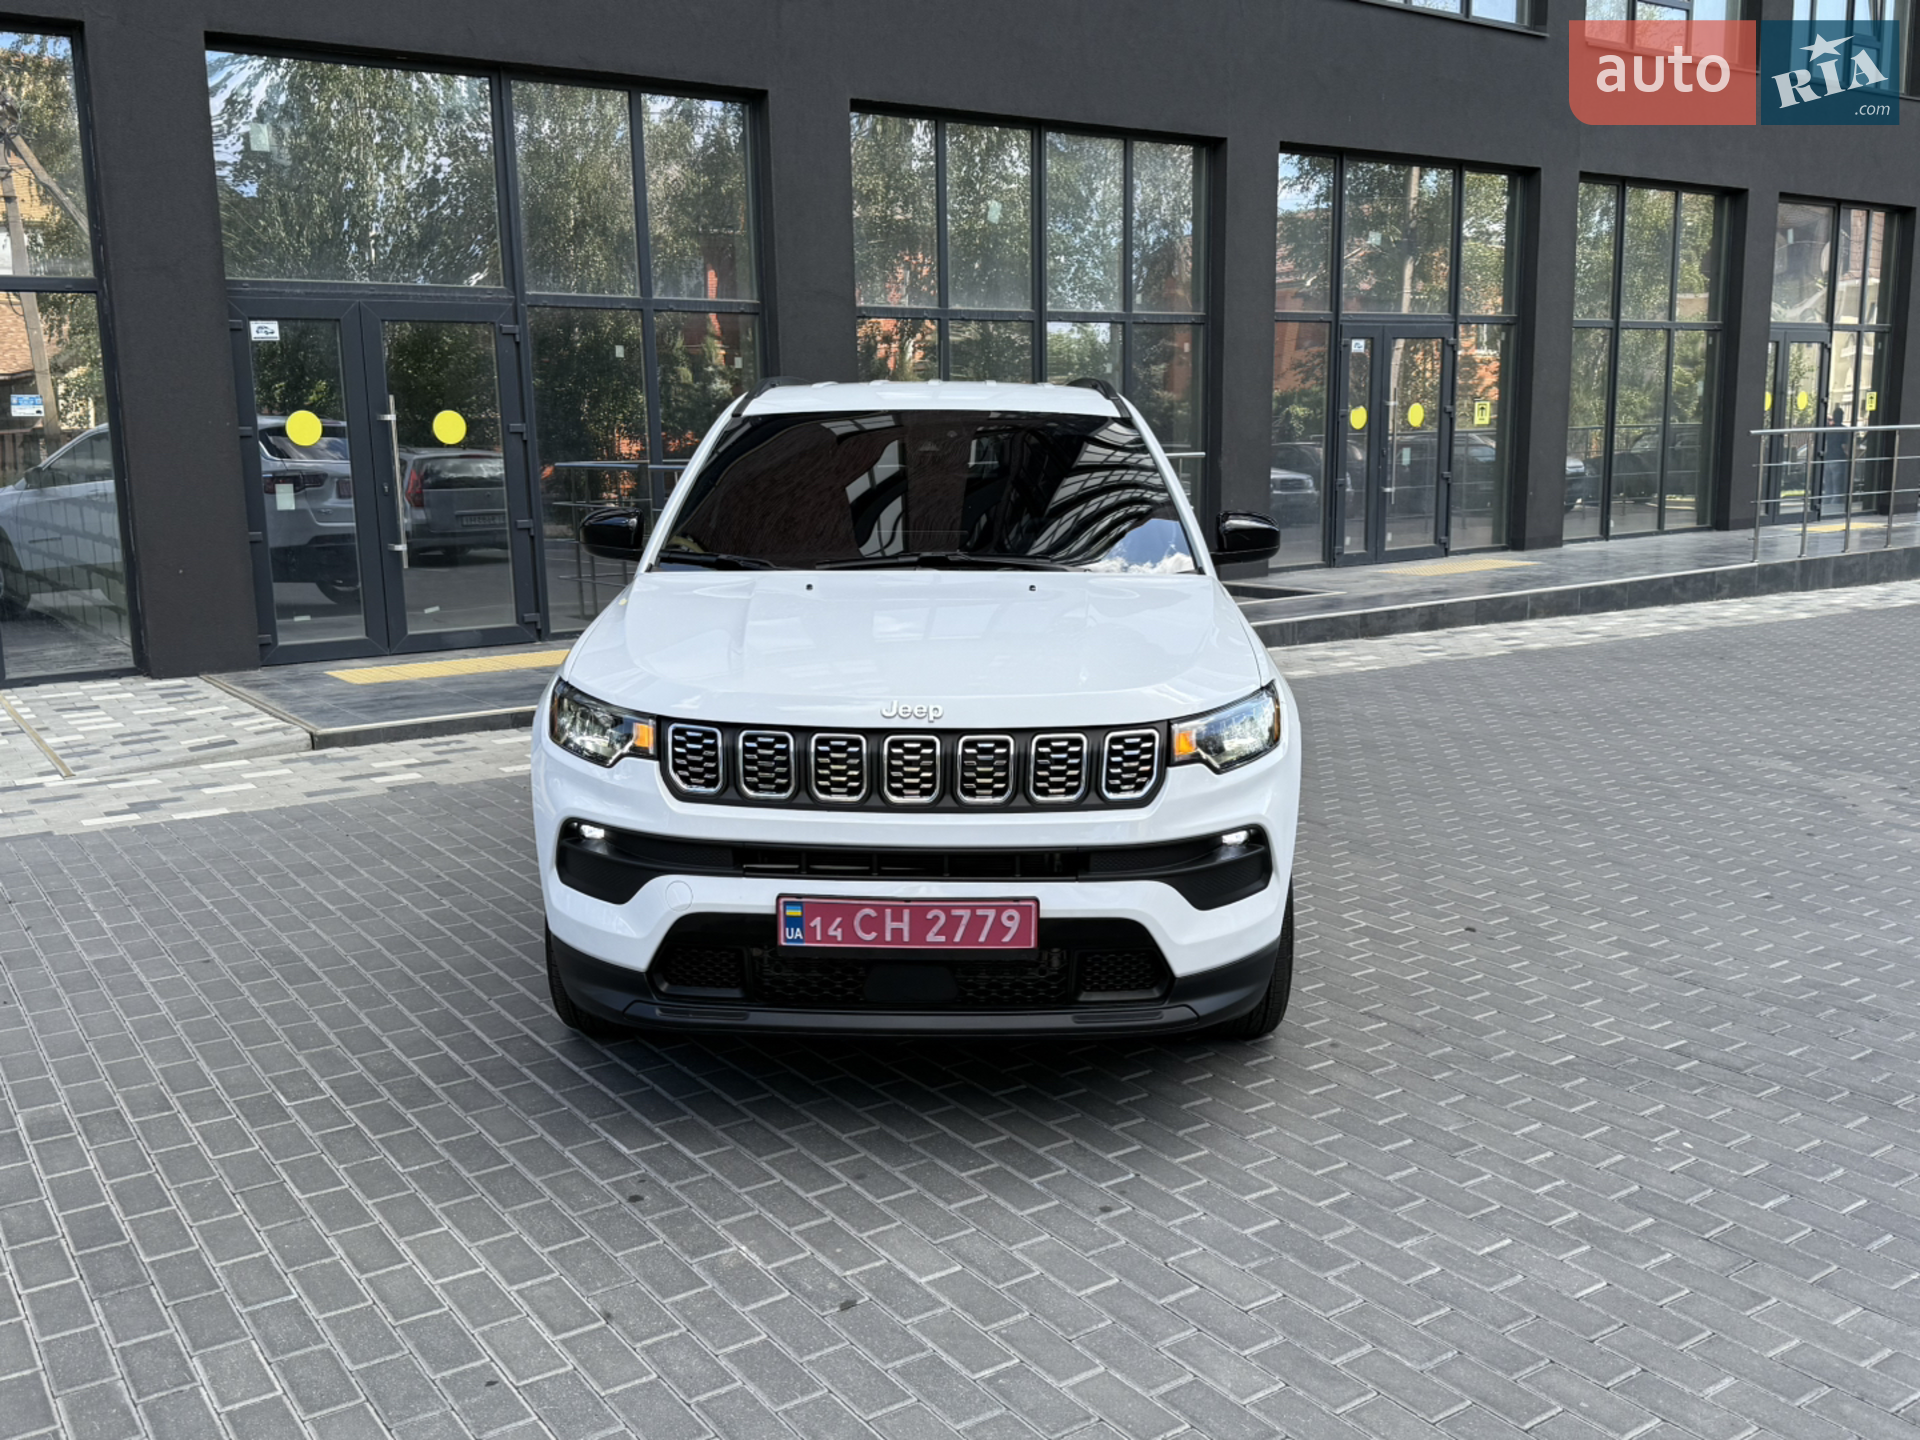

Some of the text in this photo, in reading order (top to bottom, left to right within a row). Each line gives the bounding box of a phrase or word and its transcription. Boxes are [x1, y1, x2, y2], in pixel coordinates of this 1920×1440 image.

[880, 700, 944, 723] Jeep
[785, 927, 803, 940] UA
[809, 908, 1021, 942] 14 CH 2779
